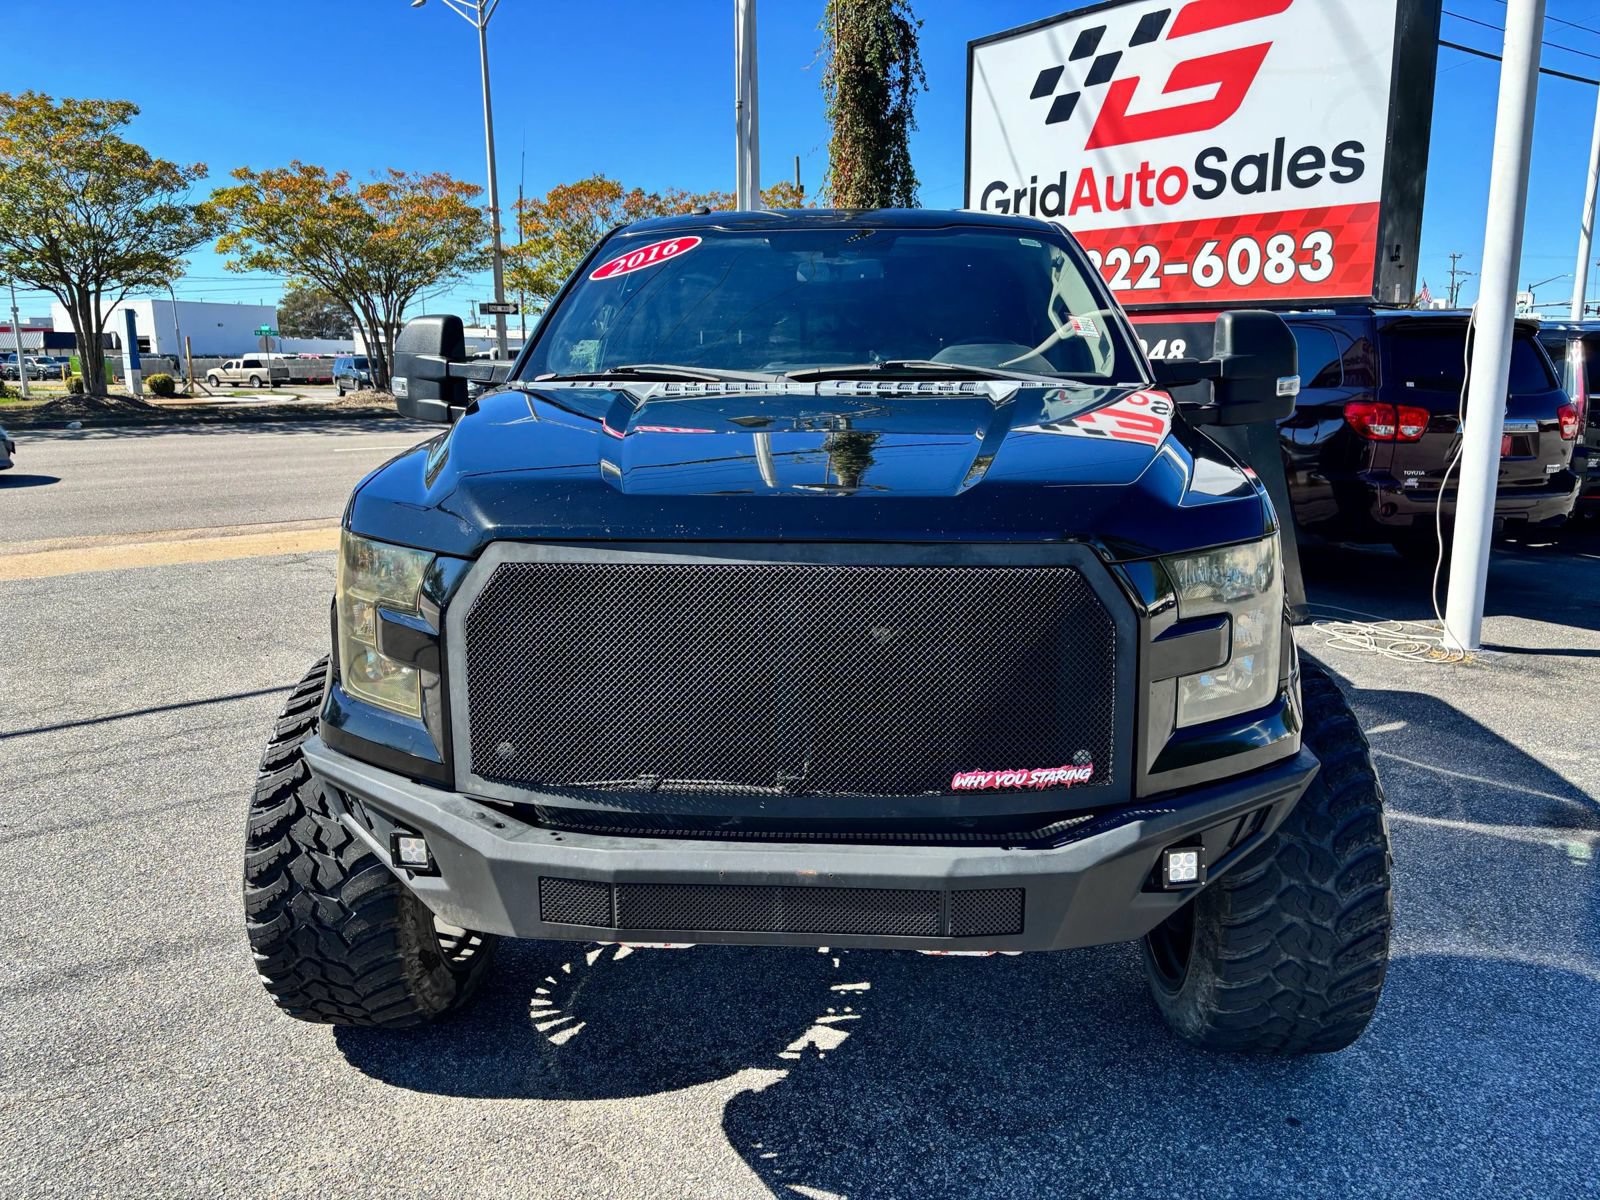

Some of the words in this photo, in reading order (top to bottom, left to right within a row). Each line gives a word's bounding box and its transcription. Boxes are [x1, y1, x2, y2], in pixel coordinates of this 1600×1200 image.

[980, 136, 1366, 218] GridAutoSales
[608, 240, 679, 276] 2016
[953, 774, 993, 788] WHY
[994, 772, 1028, 787] YOU
[1026, 767, 1092, 785] STARING
